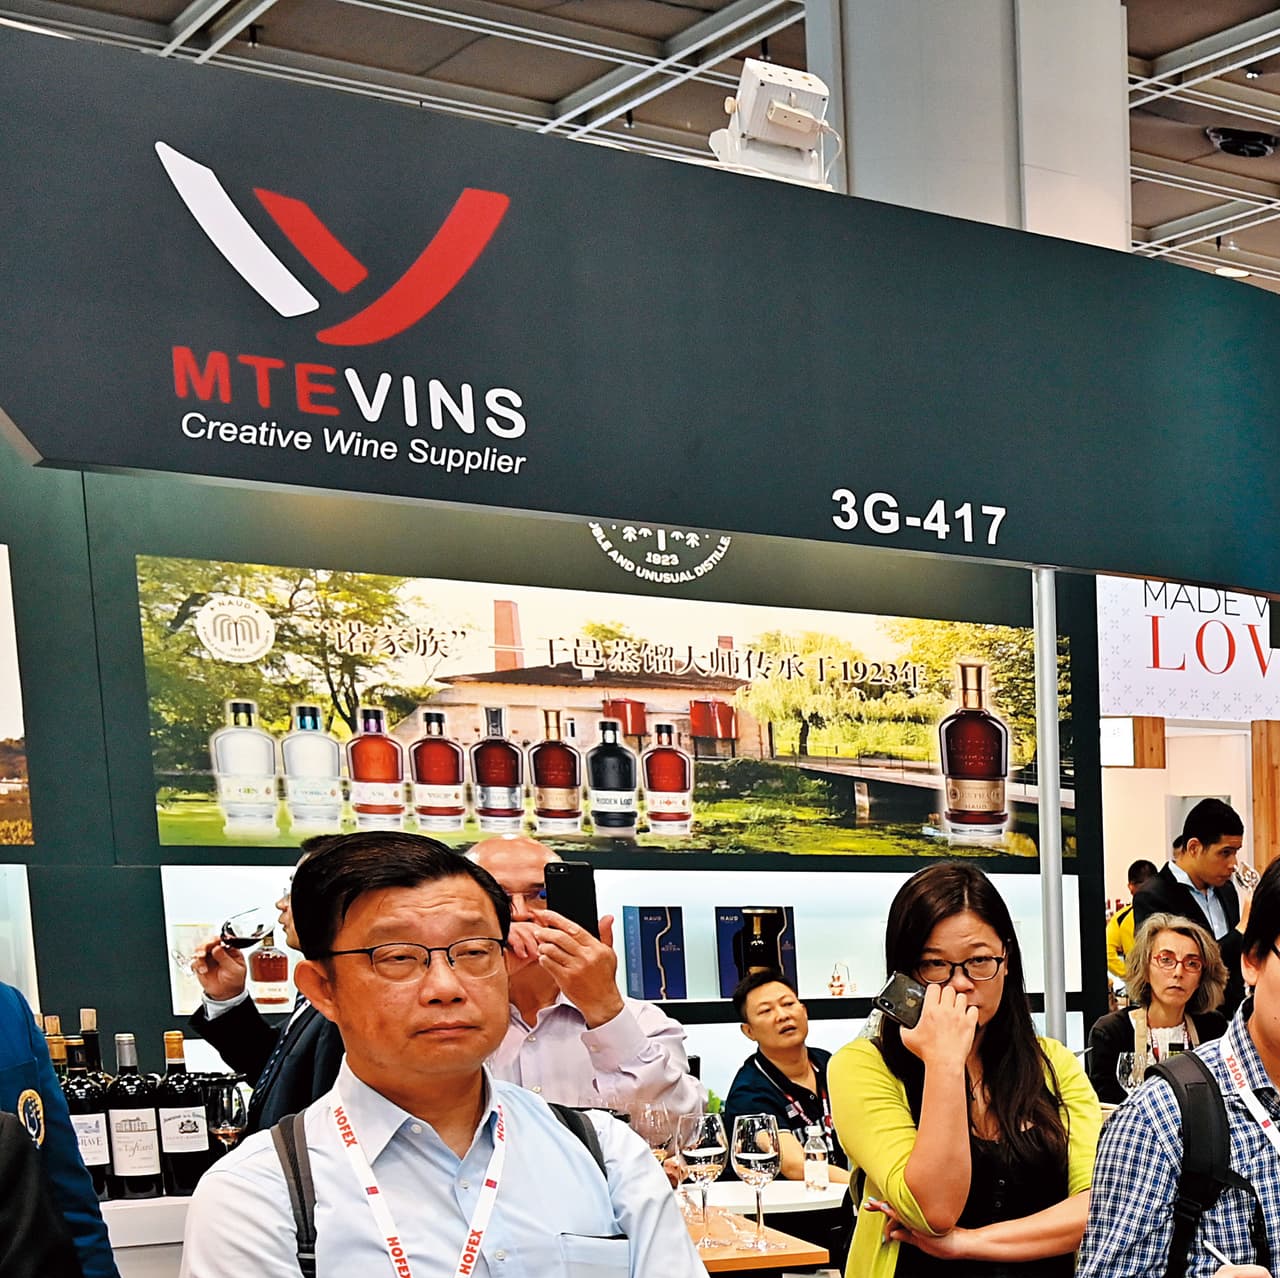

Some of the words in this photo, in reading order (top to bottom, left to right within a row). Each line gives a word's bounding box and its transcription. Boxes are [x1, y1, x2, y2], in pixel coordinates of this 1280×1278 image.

[171, 345, 527, 440] MTEVINS
[180, 411, 312, 451] Creative
[321, 427, 398, 462] Wine
[406, 438, 527, 476] Supplier
[830, 488, 1008, 546] 3G-417
[607, 548, 636, 573] AND
[634, 564, 697, 585] UNUSUAL
[693, 534, 733, 578] DISTILLE
[645, 551, 680, 567] 1923
[1225, 1054, 1247, 1089] HOFEX
[332, 1105, 357, 1148] HOFEX
[458, 1228, 484, 1277] HOFEX
